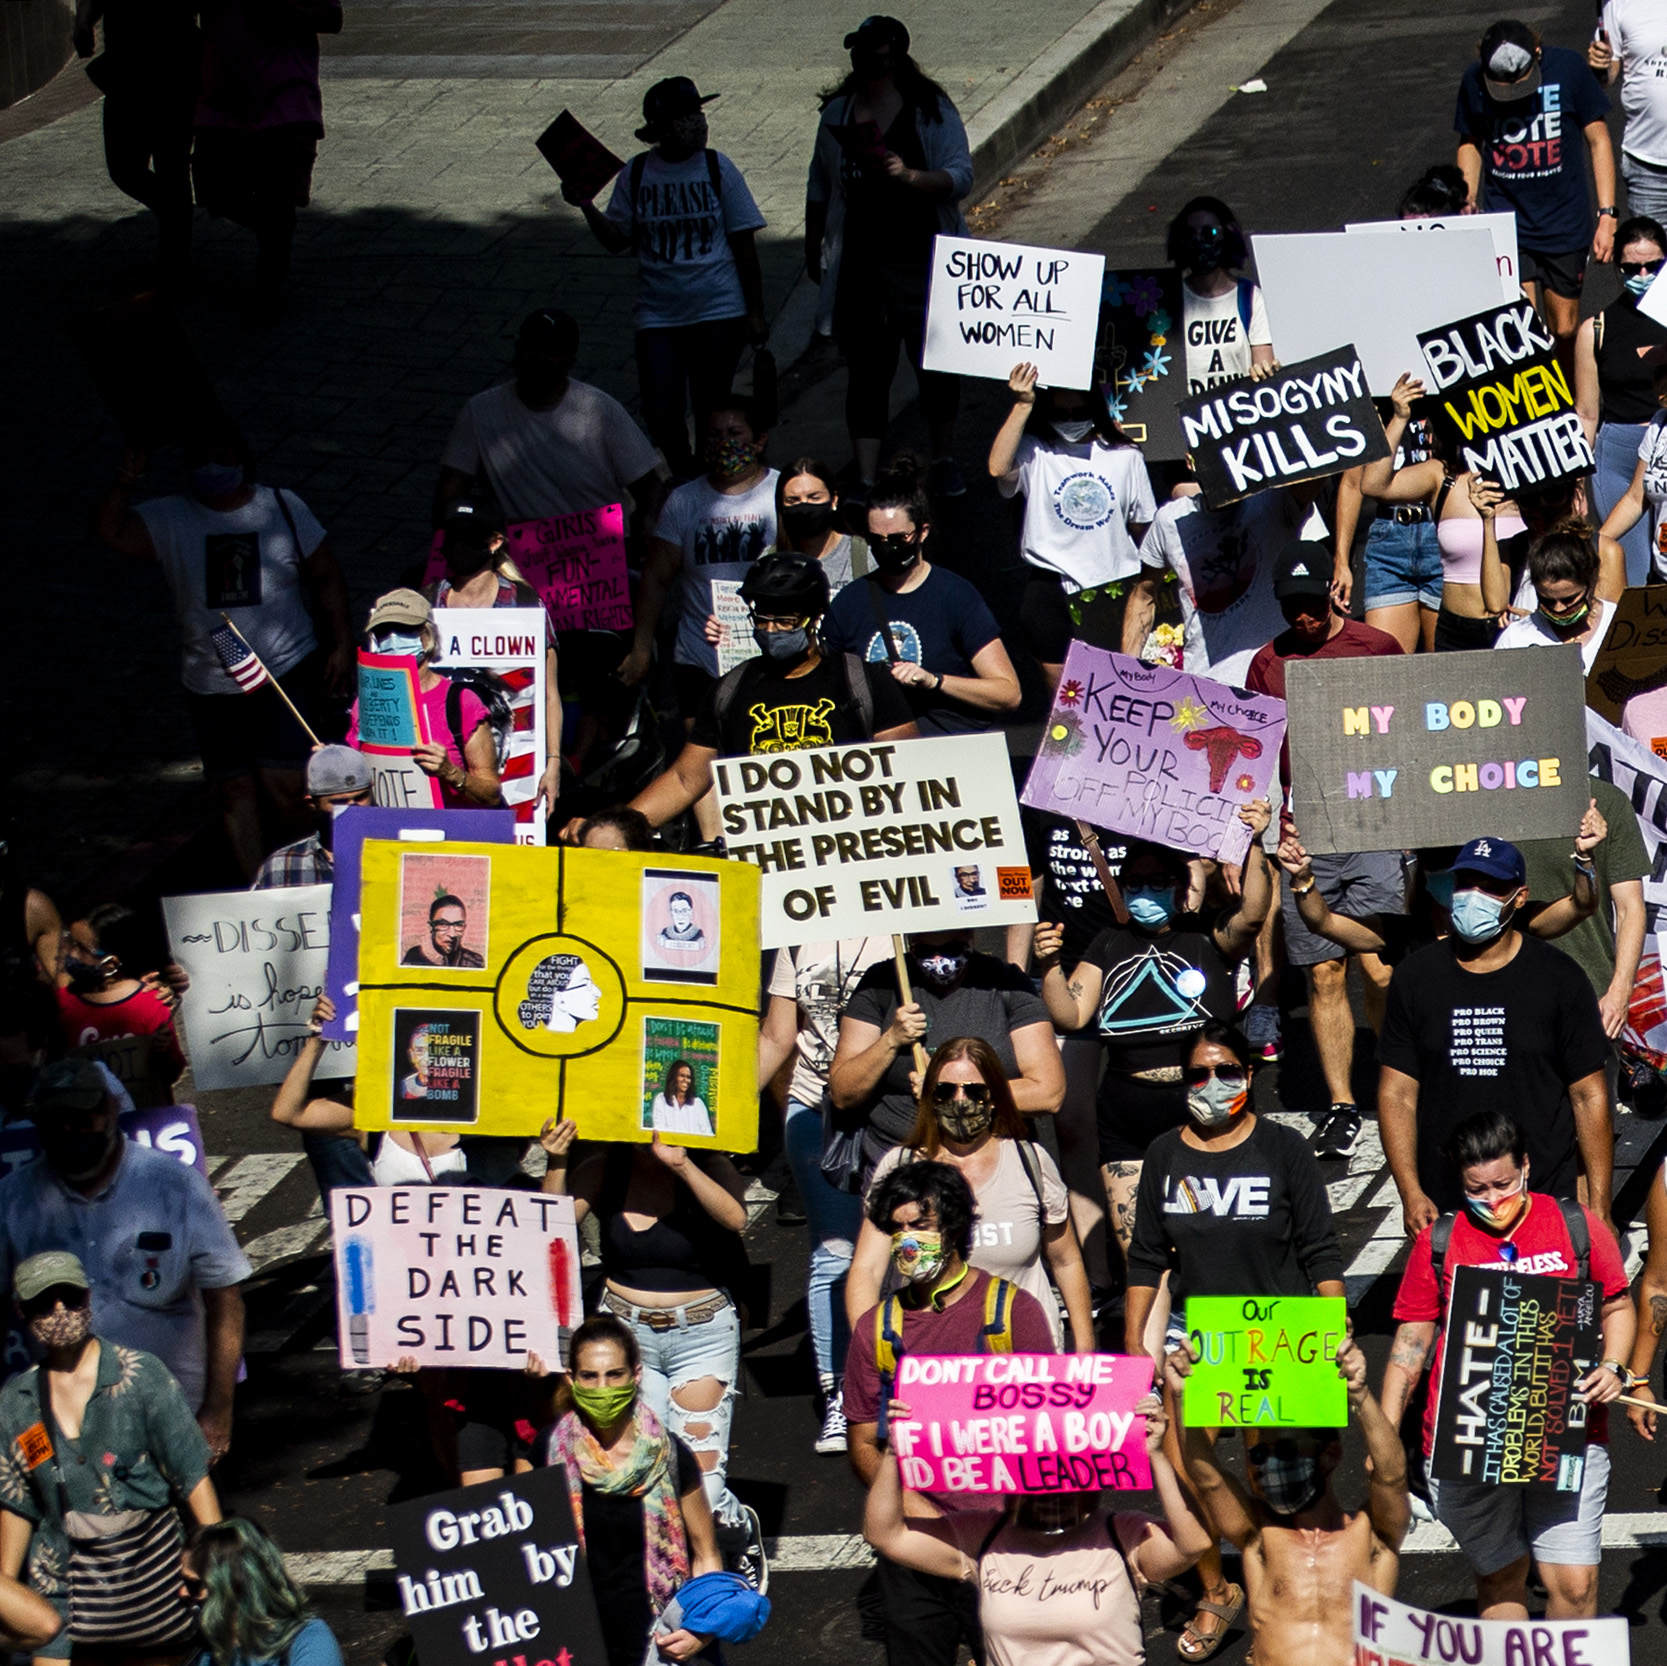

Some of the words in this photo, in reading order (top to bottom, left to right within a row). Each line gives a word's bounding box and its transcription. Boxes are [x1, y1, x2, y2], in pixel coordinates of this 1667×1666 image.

[947, 250, 1026, 282] SHOW
[1036, 260, 1070, 286] UP
[957, 283, 1004, 311] FOR
[1012, 287, 1059, 313] ALL
[960, 322, 1055, 351] WOMEN
[1424, 304, 1557, 396] BLACK
[1180, 362, 1365, 450] MISOGYNY
[1445, 361, 1574, 440] WOMEN
[1222, 419, 1367, 492] KILLS
[1462, 415, 1595, 492] MATTER
[1343, 705, 1394, 736] MY
[1426, 696, 1527, 730] BODY
[716, 764, 731, 796] I
[740, 758, 802, 793] DO
[810, 746, 896, 784] NOT
[1347, 767, 1398, 798] MY
[1430, 758, 1561, 793] CHOICE
[722, 791, 853, 834] STAND
[859, 781, 906, 816] BY
[917, 777, 961, 811] IN
[729, 839, 805, 874] THE
[811, 816, 1004, 866] PRESENCE
[783, 885, 837, 920] OF
[859, 876, 940, 911] EVIL
[1475, 1008, 1505, 1016] BLACK
[344, 1193, 557, 1233] DEFEAT
[418, 1233, 505, 1258] THE
[407, 1268, 529, 1299] DARK
[397, 1316, 529, 1354] SIDE
[1190, 1329, 1339, 1364] OUTRAGE
[984, 1356, 1056, 1378] CALL
[1065, 1356, 1115, 1383] ME
[1243, 1368, 1273, 1390] IS
[972, 1382, 1097, 1411] BOSSY
[1217, 1392, 1295, 1424] REAL
[895, 1421, 920, 1454] IF
[929, 1423, 944, 1454] I
[951, 1415, 1028, 1455] WERE
[1035, 1411, 1058, 1452] A
[1066, 1411, 1137, 1453] BOY
[941, 1457, 982, 1490] BE
[986, 1457, 1016, 1492] A
[1020, 1454, 1137, 1492] LEADER
[425, 1492, 535, 1552] Grab
[399, 1567, 483, 1617] him
[525, 1538, 580, 1587] by
[462, 1605, 542, 1653] the
